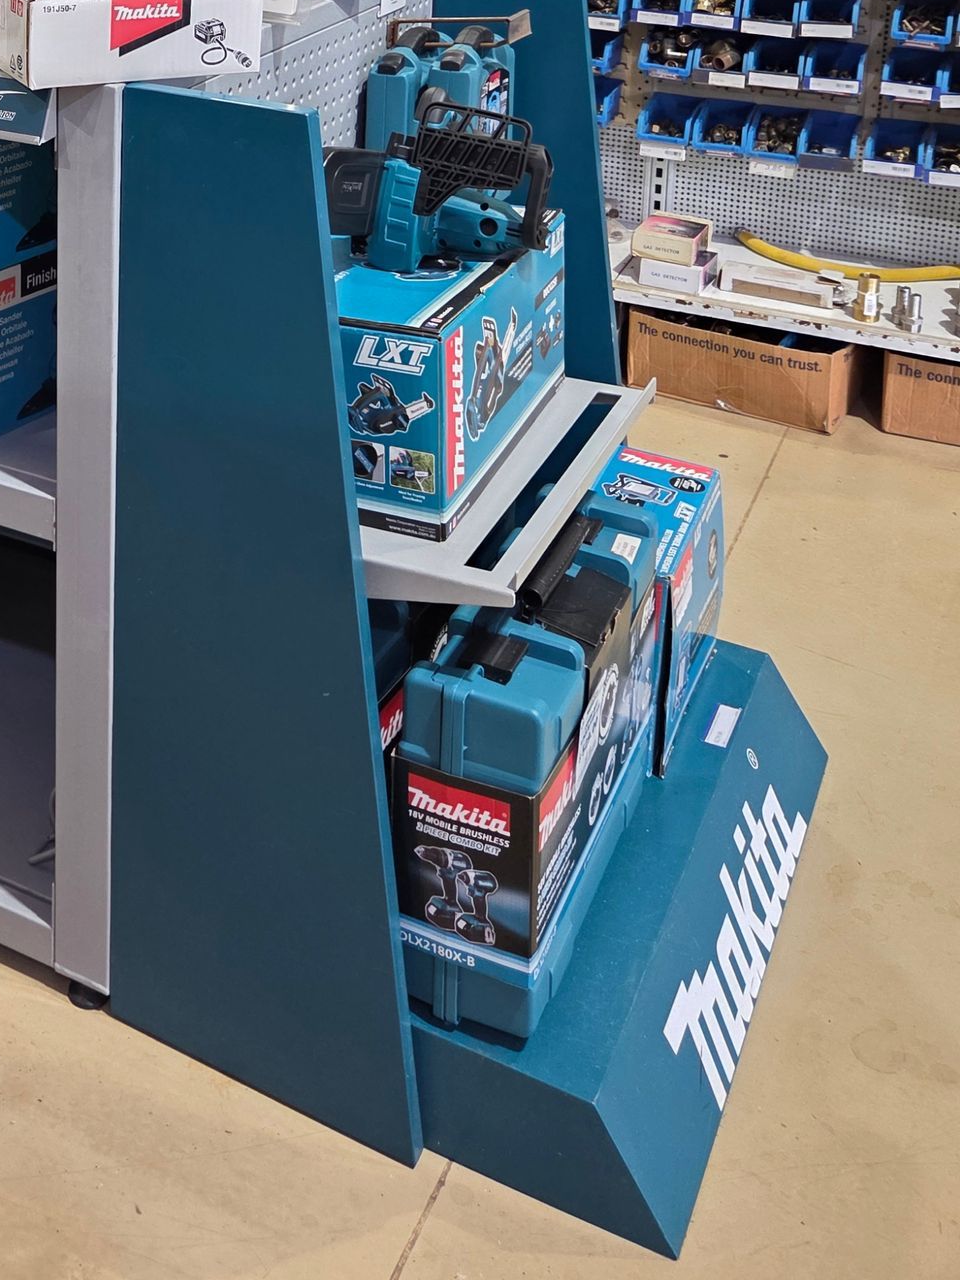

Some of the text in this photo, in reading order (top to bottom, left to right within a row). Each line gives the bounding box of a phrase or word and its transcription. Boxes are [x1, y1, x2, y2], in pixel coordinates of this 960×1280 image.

[0, 310, 23, 325] Sander
[353, 334, 434, 376] LXT
[637, 321, 823, 373] The connection you can trust.
[897, 362, 921, 379] The
[408, 809, 510, 848] 18V MOBILE BRUSHLESS
[415, 822, 501, 856] 2 PIECE COMBO KIT
